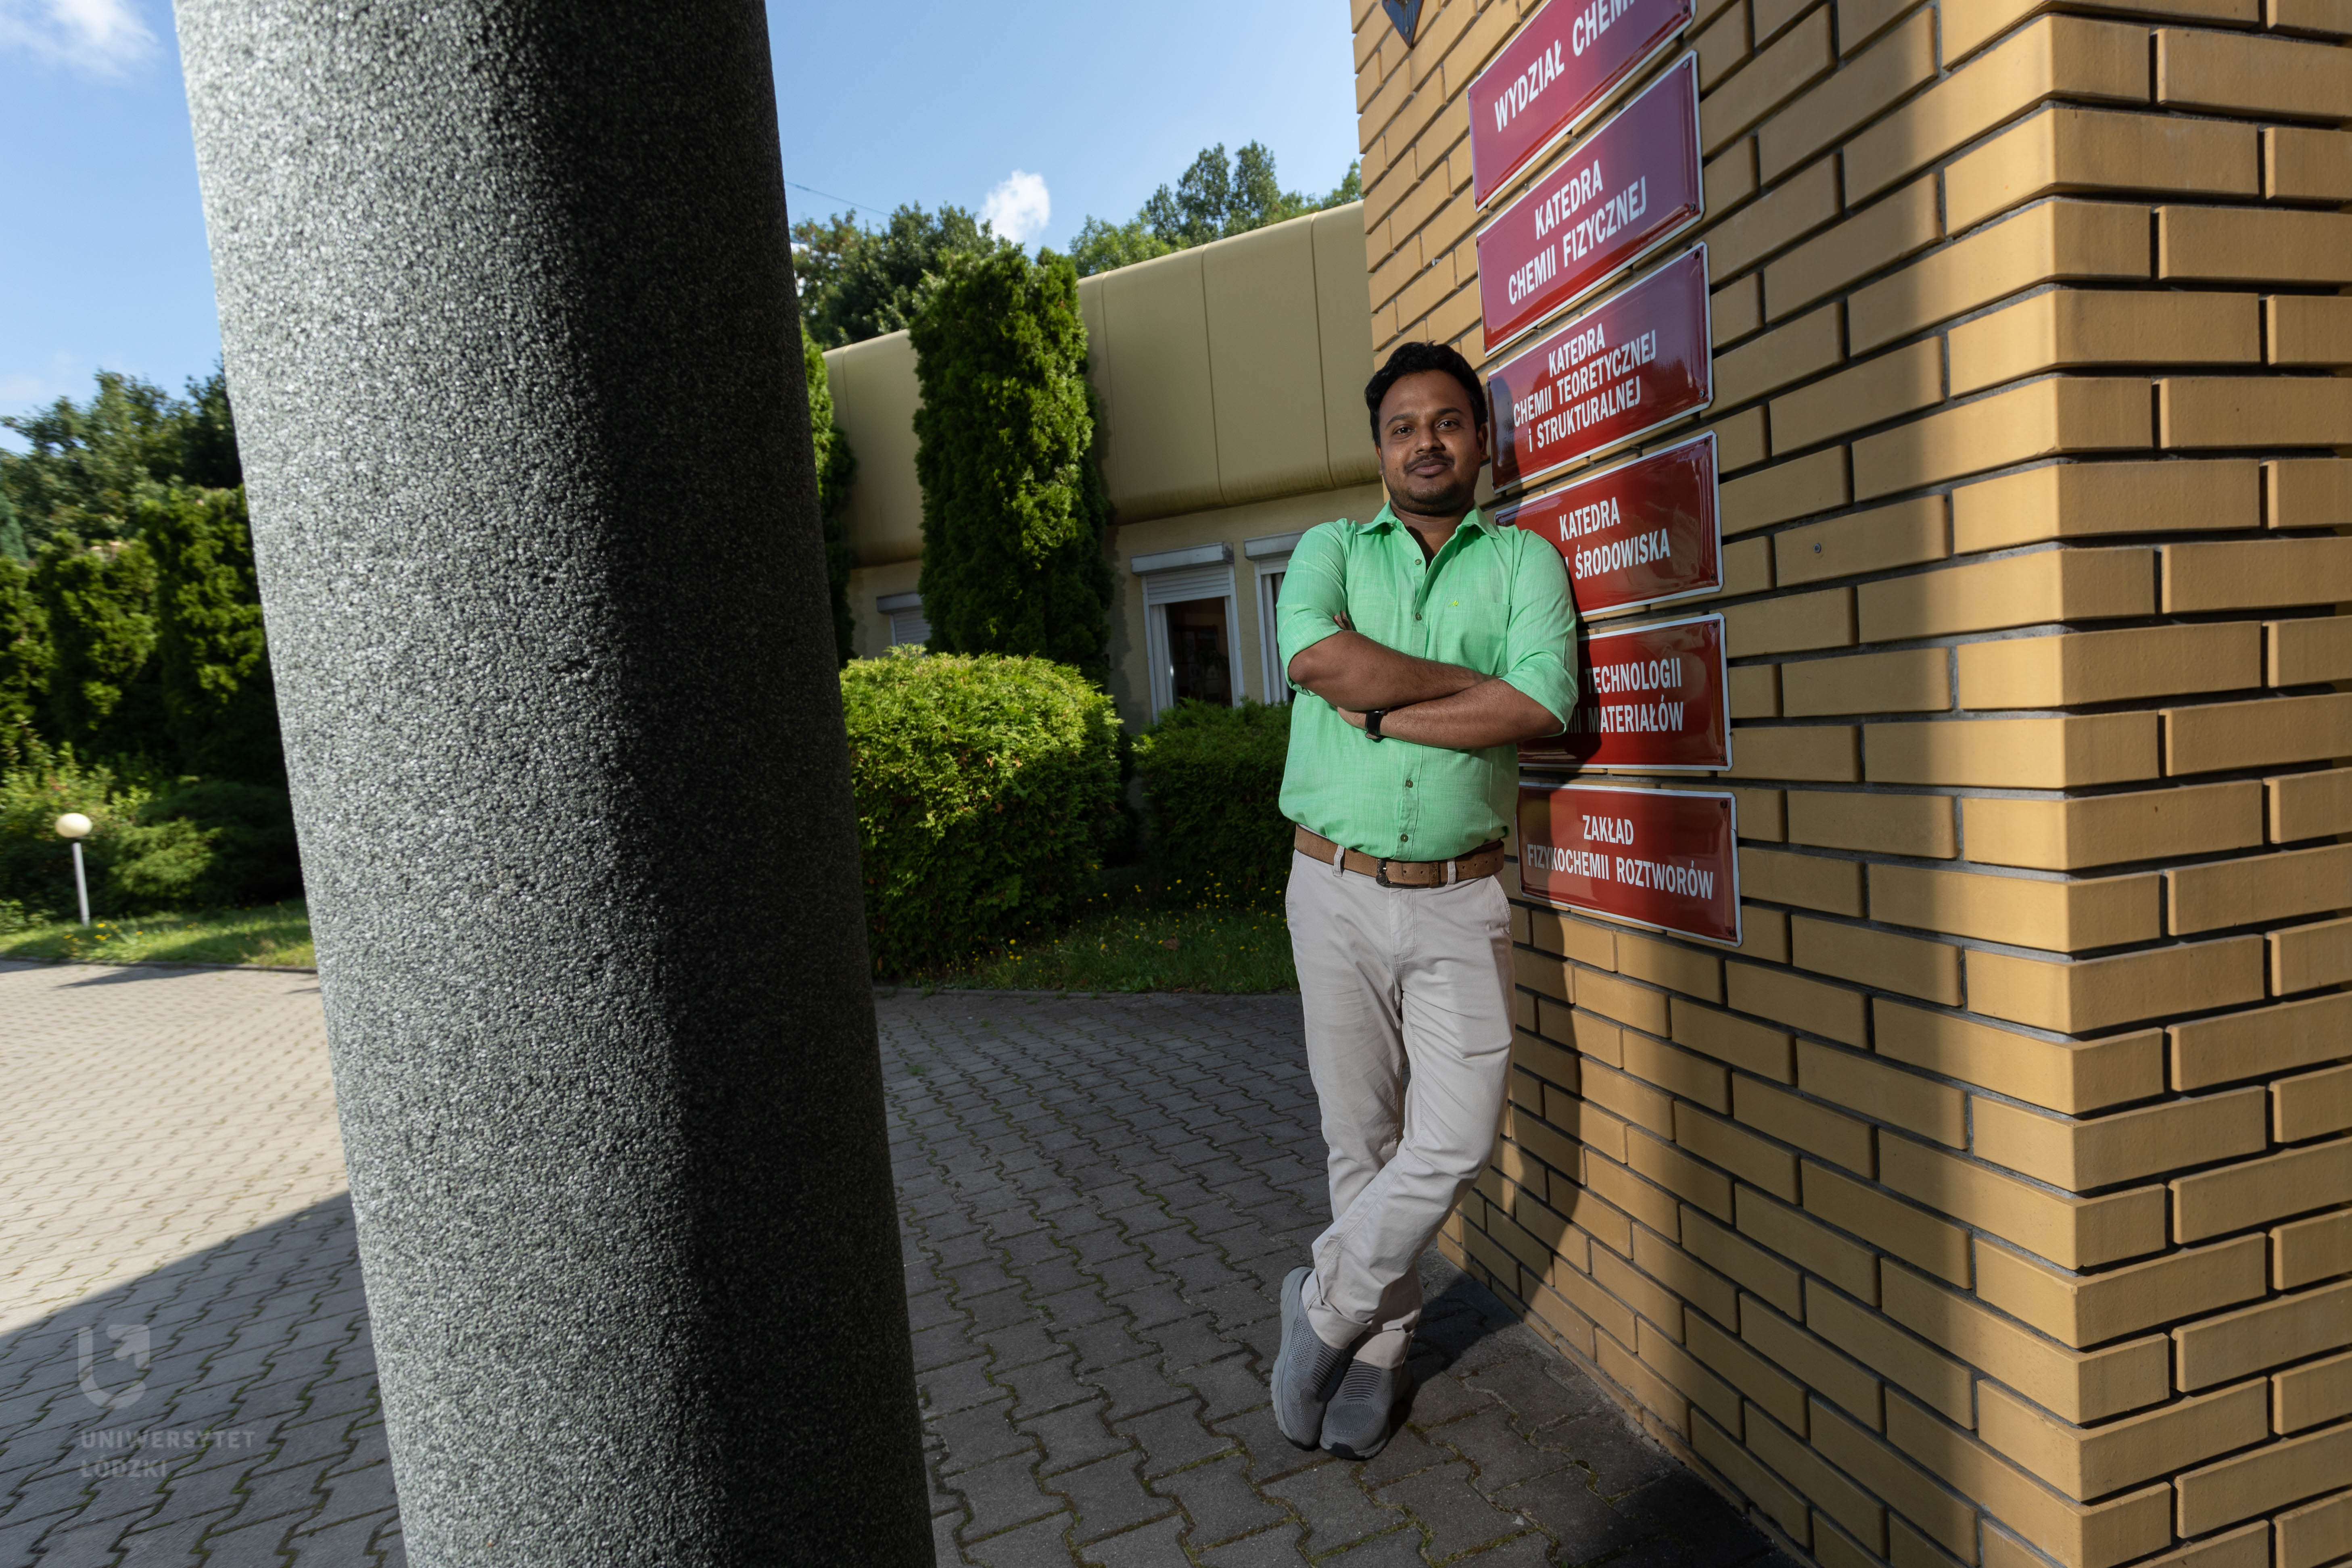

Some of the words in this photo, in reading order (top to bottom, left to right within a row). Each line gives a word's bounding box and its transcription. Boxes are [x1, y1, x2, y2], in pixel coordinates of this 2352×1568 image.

[1494, 39, 1565, 132] WYDZIAŁ
[1573, 0, 1634, 56] CHEM
[1535, 159, 1603, 240] KATEDRA
[1509, 244, 1556, 305] CHEMII
[1563, 175, 1646, 268] FIZYCZNEJ
[1513, 386, 1552, 427] CHEMII
[1557, 329, 1656, 405] TEORETYCZNEJ
[1548, 323, 1605, 378] KATEDRA
[1528, 428, 1532, 452] i
[1537, 376, 1640, 448] STRUKTURALNEJ
[1559, 497, 1620, 541] KATEDRA
[1575, 528, 1671, 579] ŚRODOWISKA
[1585, 658, 1681, 694] TECHNOLOGII
[1587, 694, 1683, 733] MATERIAŁÓW
[1582, 815, 1633, 845] ZAKŁAD
[1527, 844, 1609, 880] FIZYKOCHEMII
[1616, 860, 1713, 900] ROZTWORÓW
